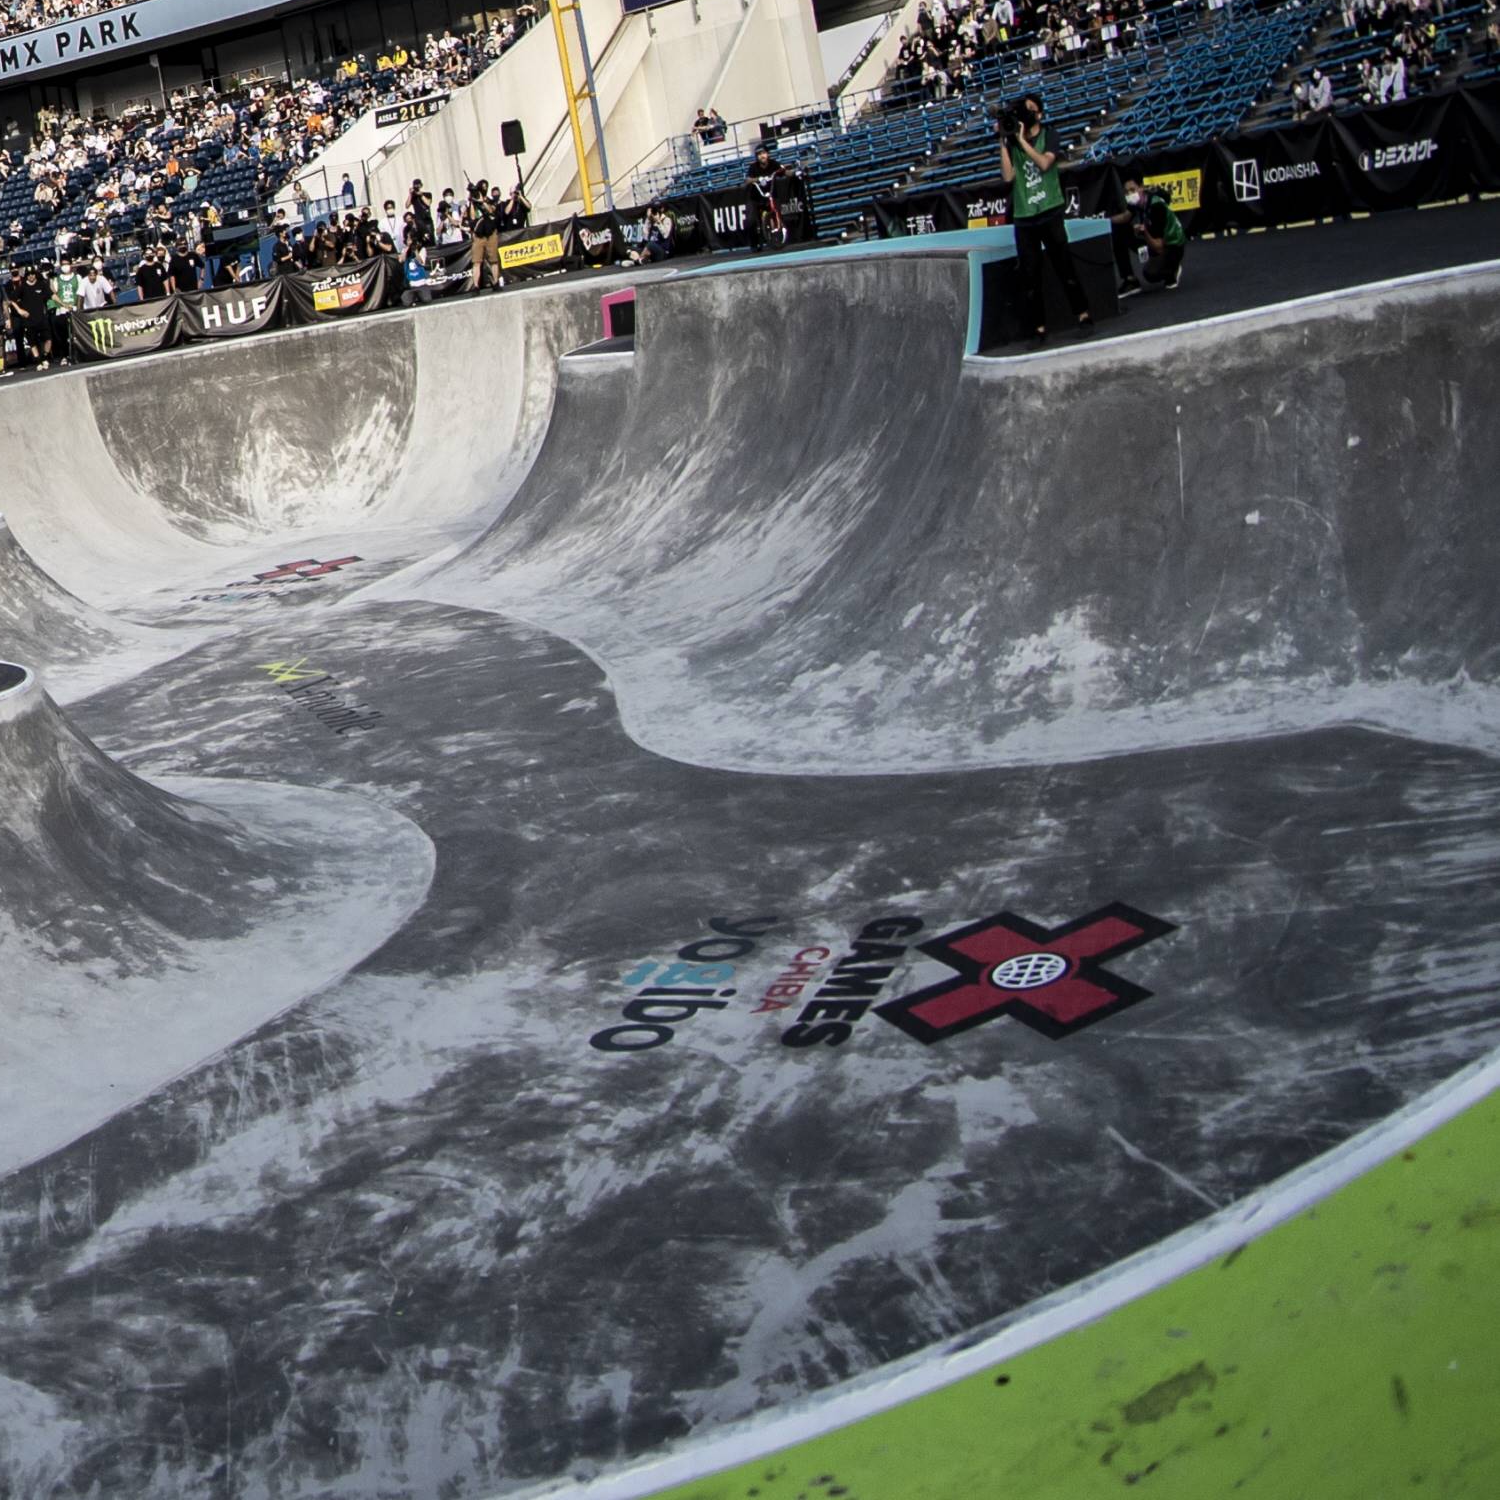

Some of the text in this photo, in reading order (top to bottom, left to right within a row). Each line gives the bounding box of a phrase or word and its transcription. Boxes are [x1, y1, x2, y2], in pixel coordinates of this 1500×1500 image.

[55, 12, 142, 58] PARK
[399, 102, 426, 122] 214
[1374, 139, 1438, 169] シミズオクト
[1263, 161, 1320, 185] KODANSHA
[713, 204, 747, 234] HUF
[967, 199, 1007, 218] スポーツくじ
[311, 273, 361, 292] スポーツくじ
[114, 314, 169, 333] MONSTER
[201, 296, 268, 330] HUF
[590, 914, 779, 1053] yogibo
[750, 945, 831, 1016] CHIBA
[780, 914, 924, 1049] GAMES
